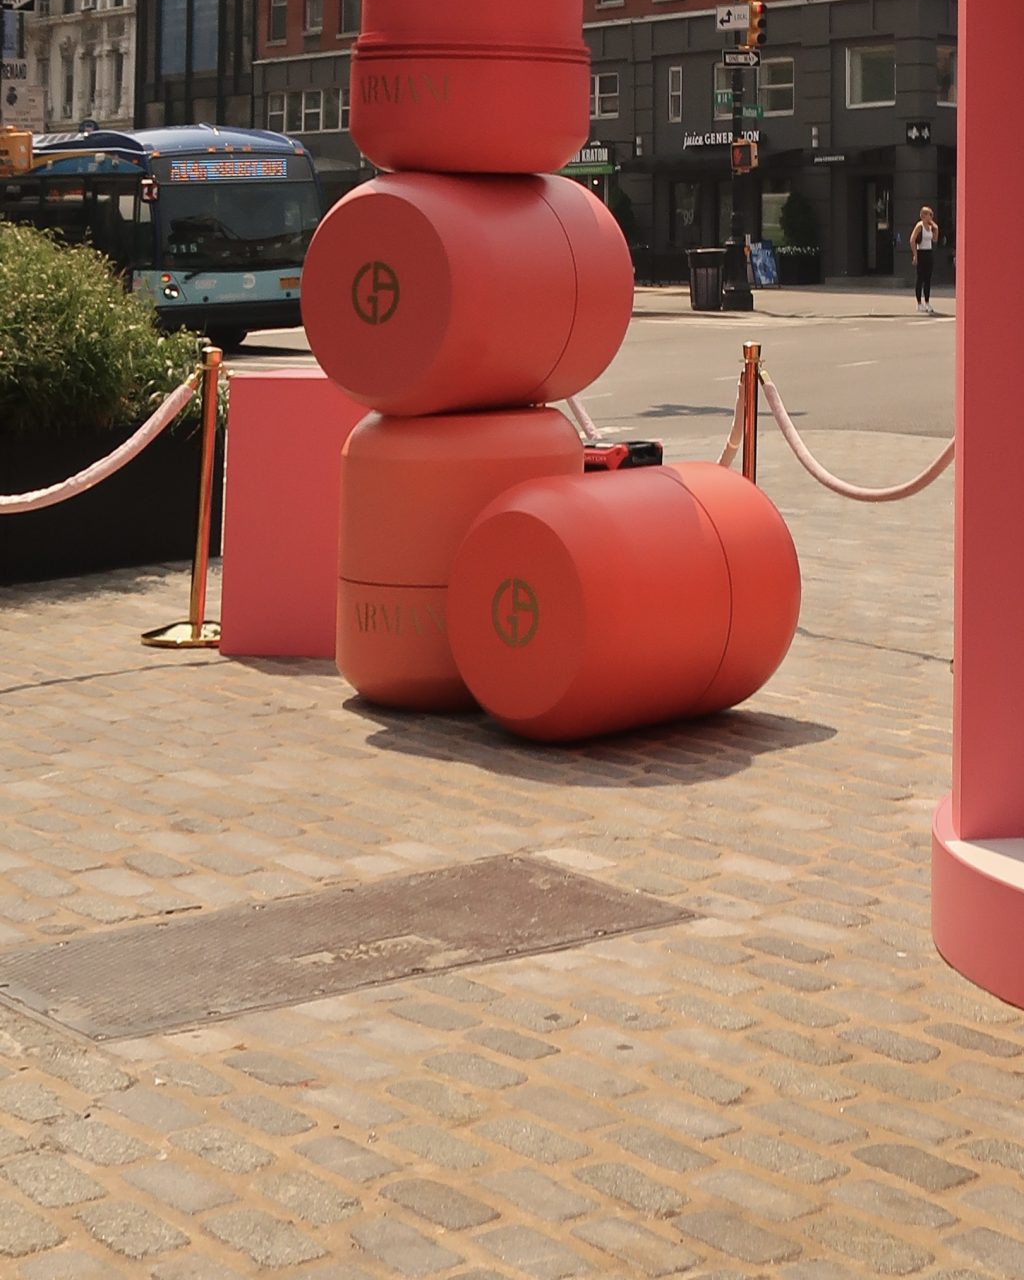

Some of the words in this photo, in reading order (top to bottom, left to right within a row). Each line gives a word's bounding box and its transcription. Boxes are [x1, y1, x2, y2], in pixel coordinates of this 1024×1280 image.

[359, 73, 450, 104] ARMANI
[682, 131, 704, 151] juice
[704, 130, 760, 145] GENERION
[581, 148, 608, 162] KRATOM
[354, 602, 447, 636] ARMAN
